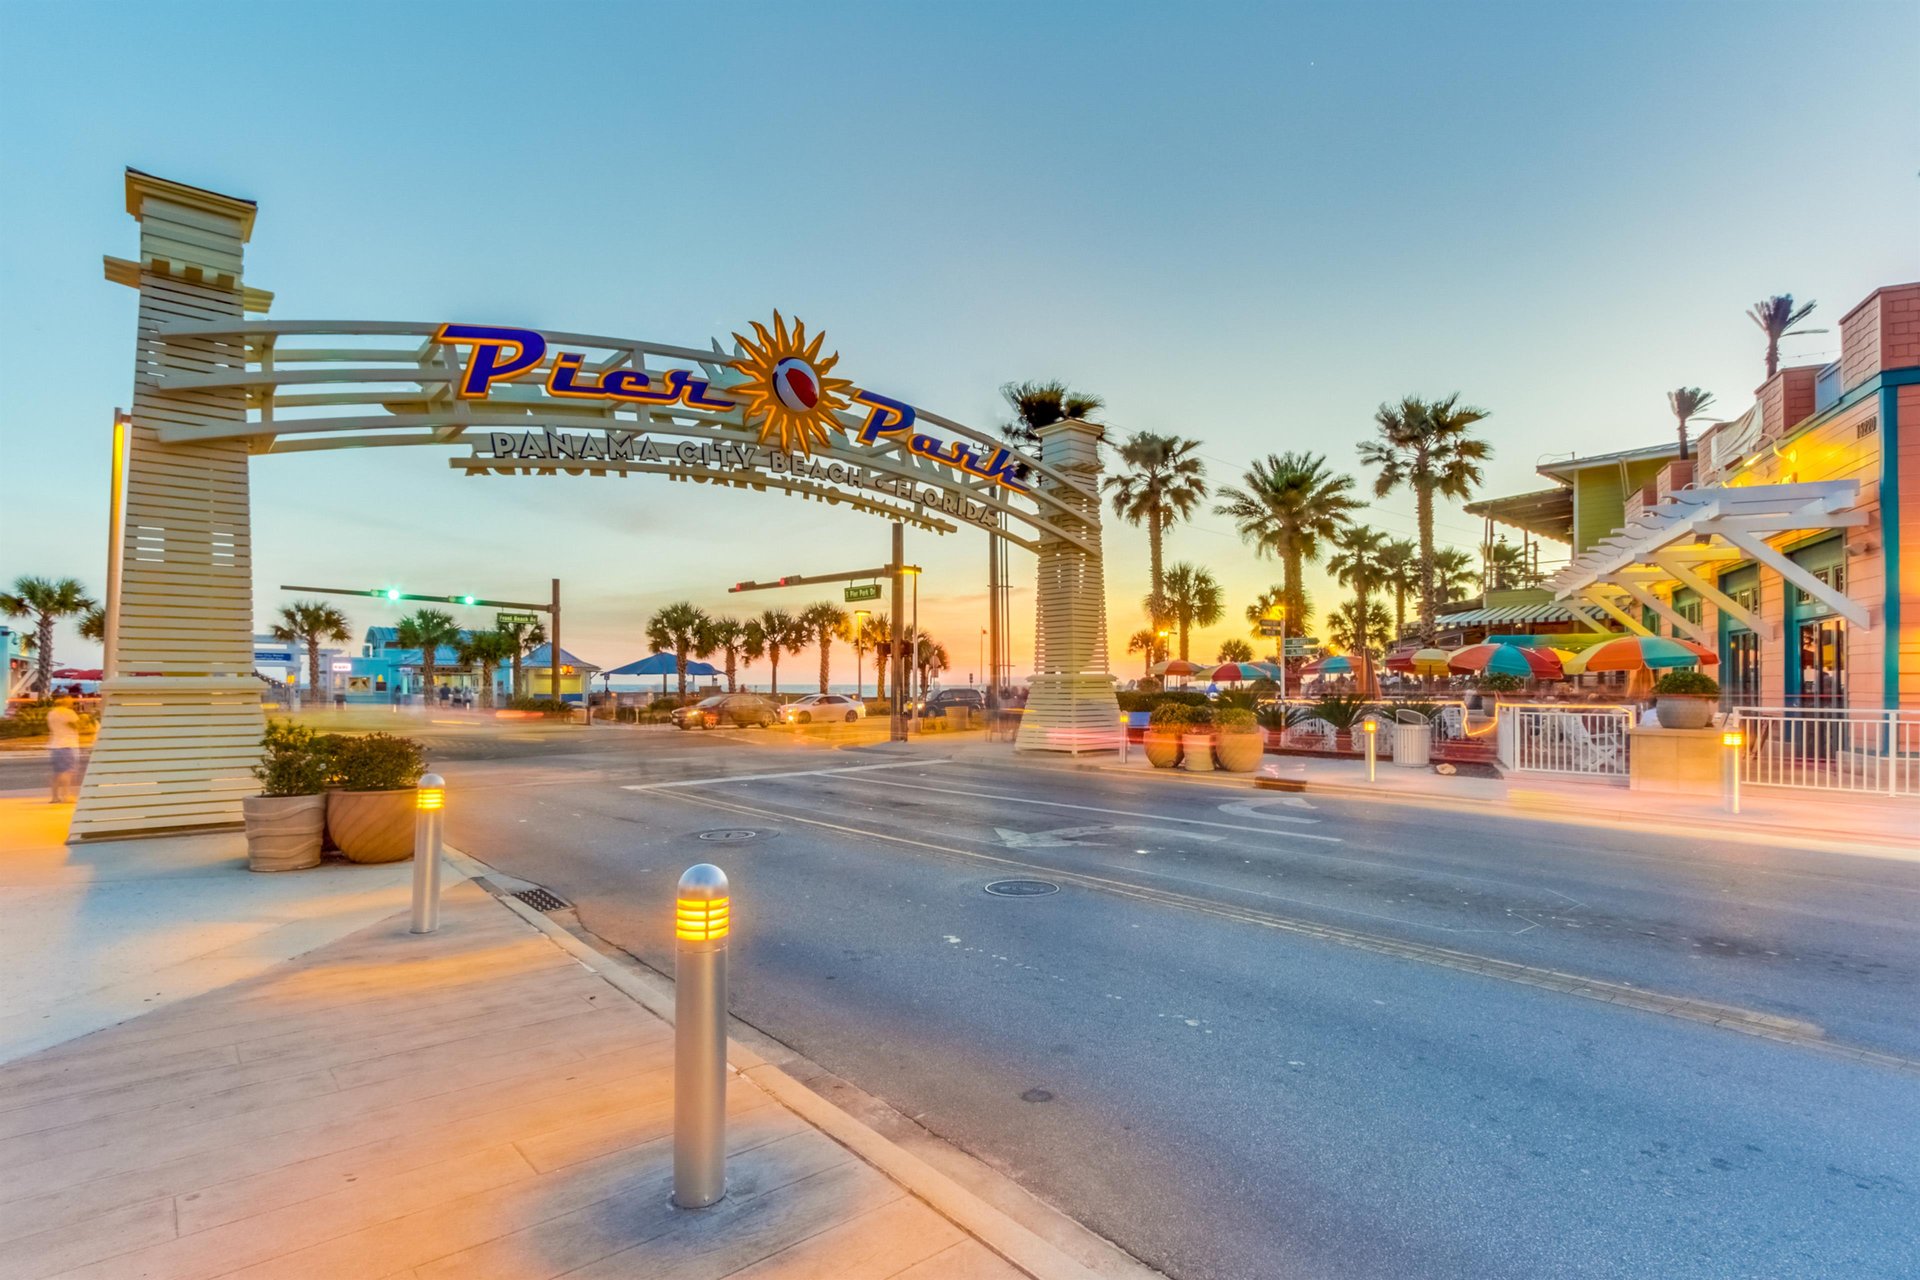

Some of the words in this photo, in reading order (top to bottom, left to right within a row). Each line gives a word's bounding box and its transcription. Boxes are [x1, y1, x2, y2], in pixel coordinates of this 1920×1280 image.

[433, 322, 736, 412] Pier
[852, 388, 1031, 494] Park
[490, 430, 662, 462] PANAMA
[676, 440, 756, 470] CITY
[770, 450, 864, 488] BEACH
[895, 477, 1000, 528] FLORIDA
[850, 590, 859, 598] Pier
[859, 589, 869, 597] Park
